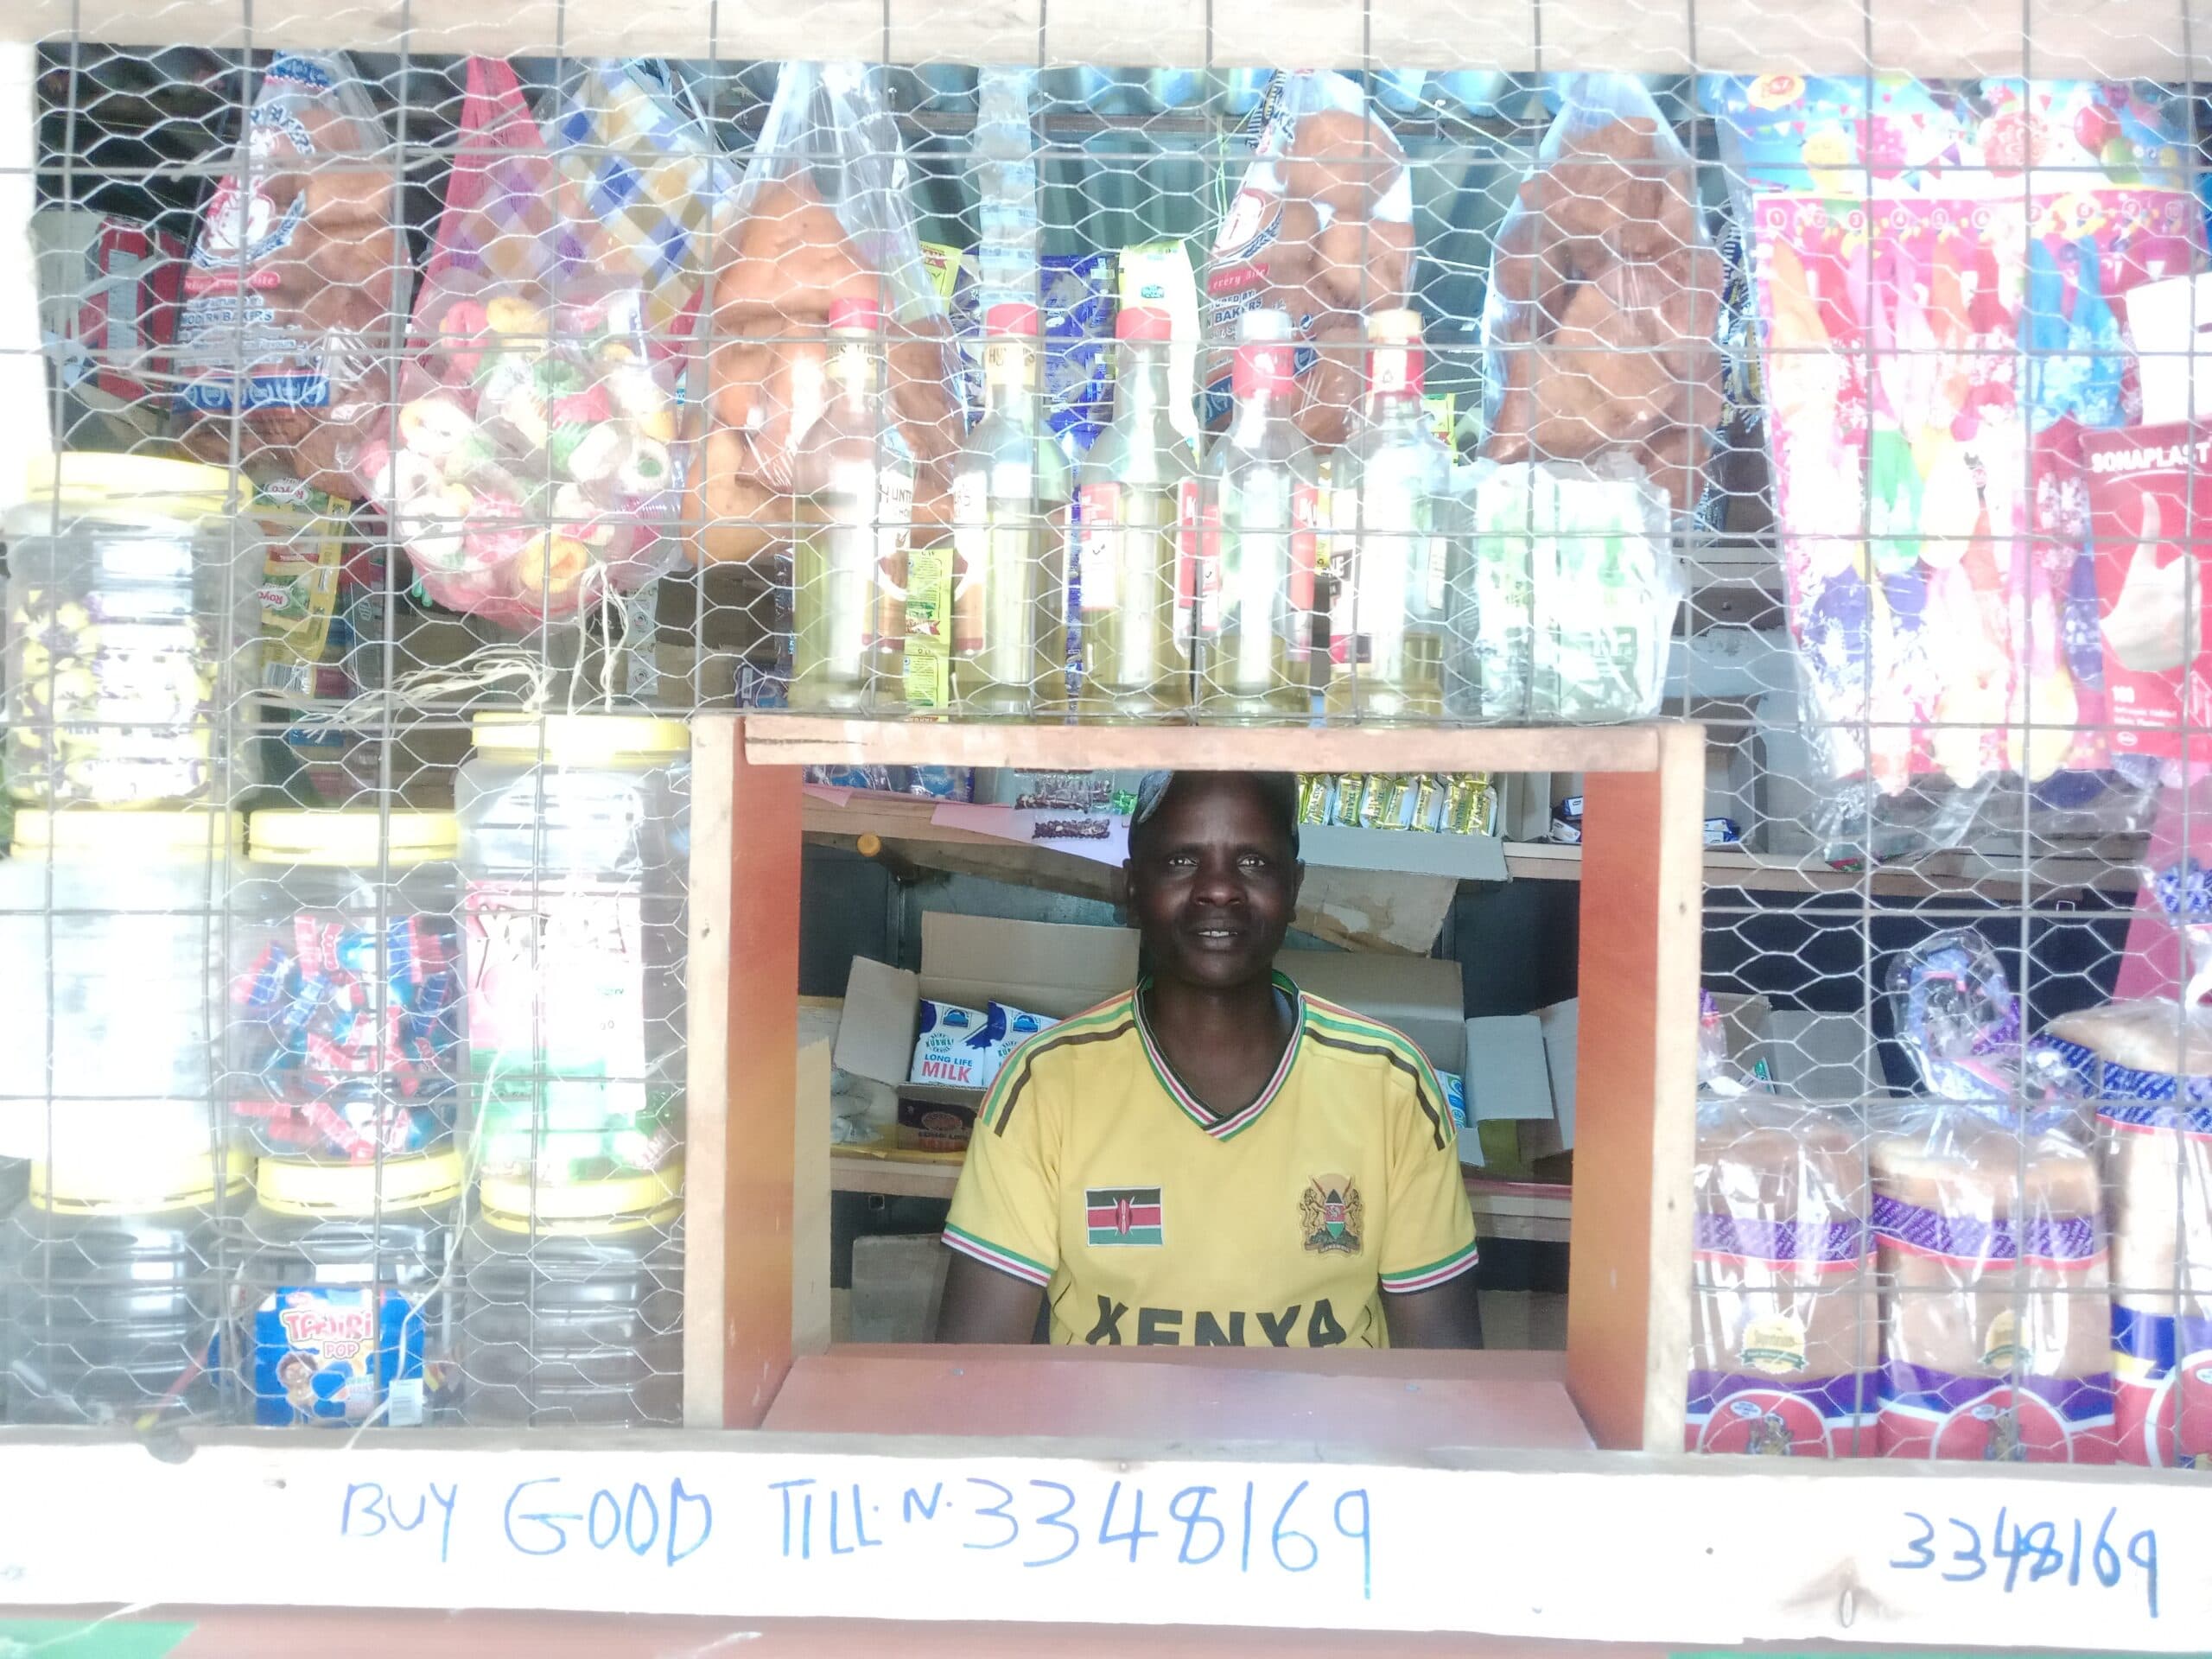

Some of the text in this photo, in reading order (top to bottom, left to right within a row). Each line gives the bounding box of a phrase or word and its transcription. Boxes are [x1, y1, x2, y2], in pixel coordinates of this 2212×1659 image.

[921, 1061, 972, 1083] MILK
[925, 1053, 973, 1067] LONG LIFE
[1085, 1294, 1346, 1348] KENYA
[325, 1342, 358, 1358] POP
[341, 1482, 457, 1562] BUY
[504, 1478, 713, 1567] GOOD
[963, 1477, 1372, 1600] 3348169
[1889, 1506, 2159, 1618] 3348169
